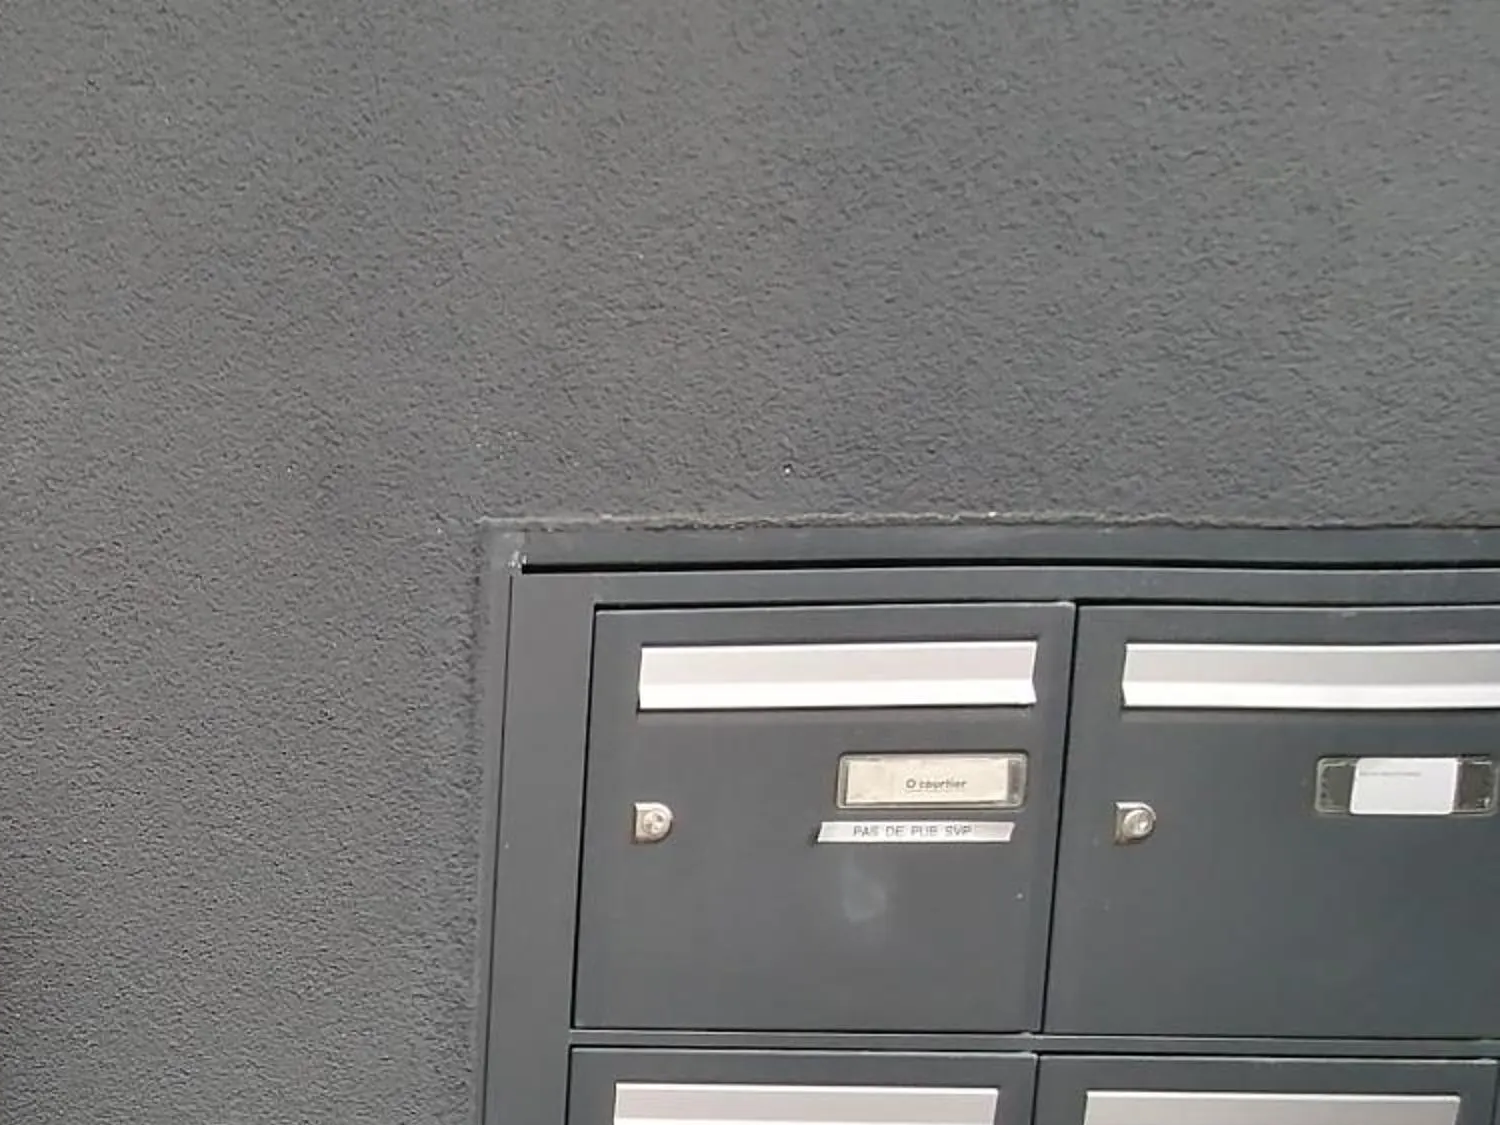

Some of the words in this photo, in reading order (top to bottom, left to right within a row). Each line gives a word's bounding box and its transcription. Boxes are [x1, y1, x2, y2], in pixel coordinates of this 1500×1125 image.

[853, 825, 880, 838] PAS
[885, 825, 905, 838] DE
[944, 825, 972, 838] SVP
